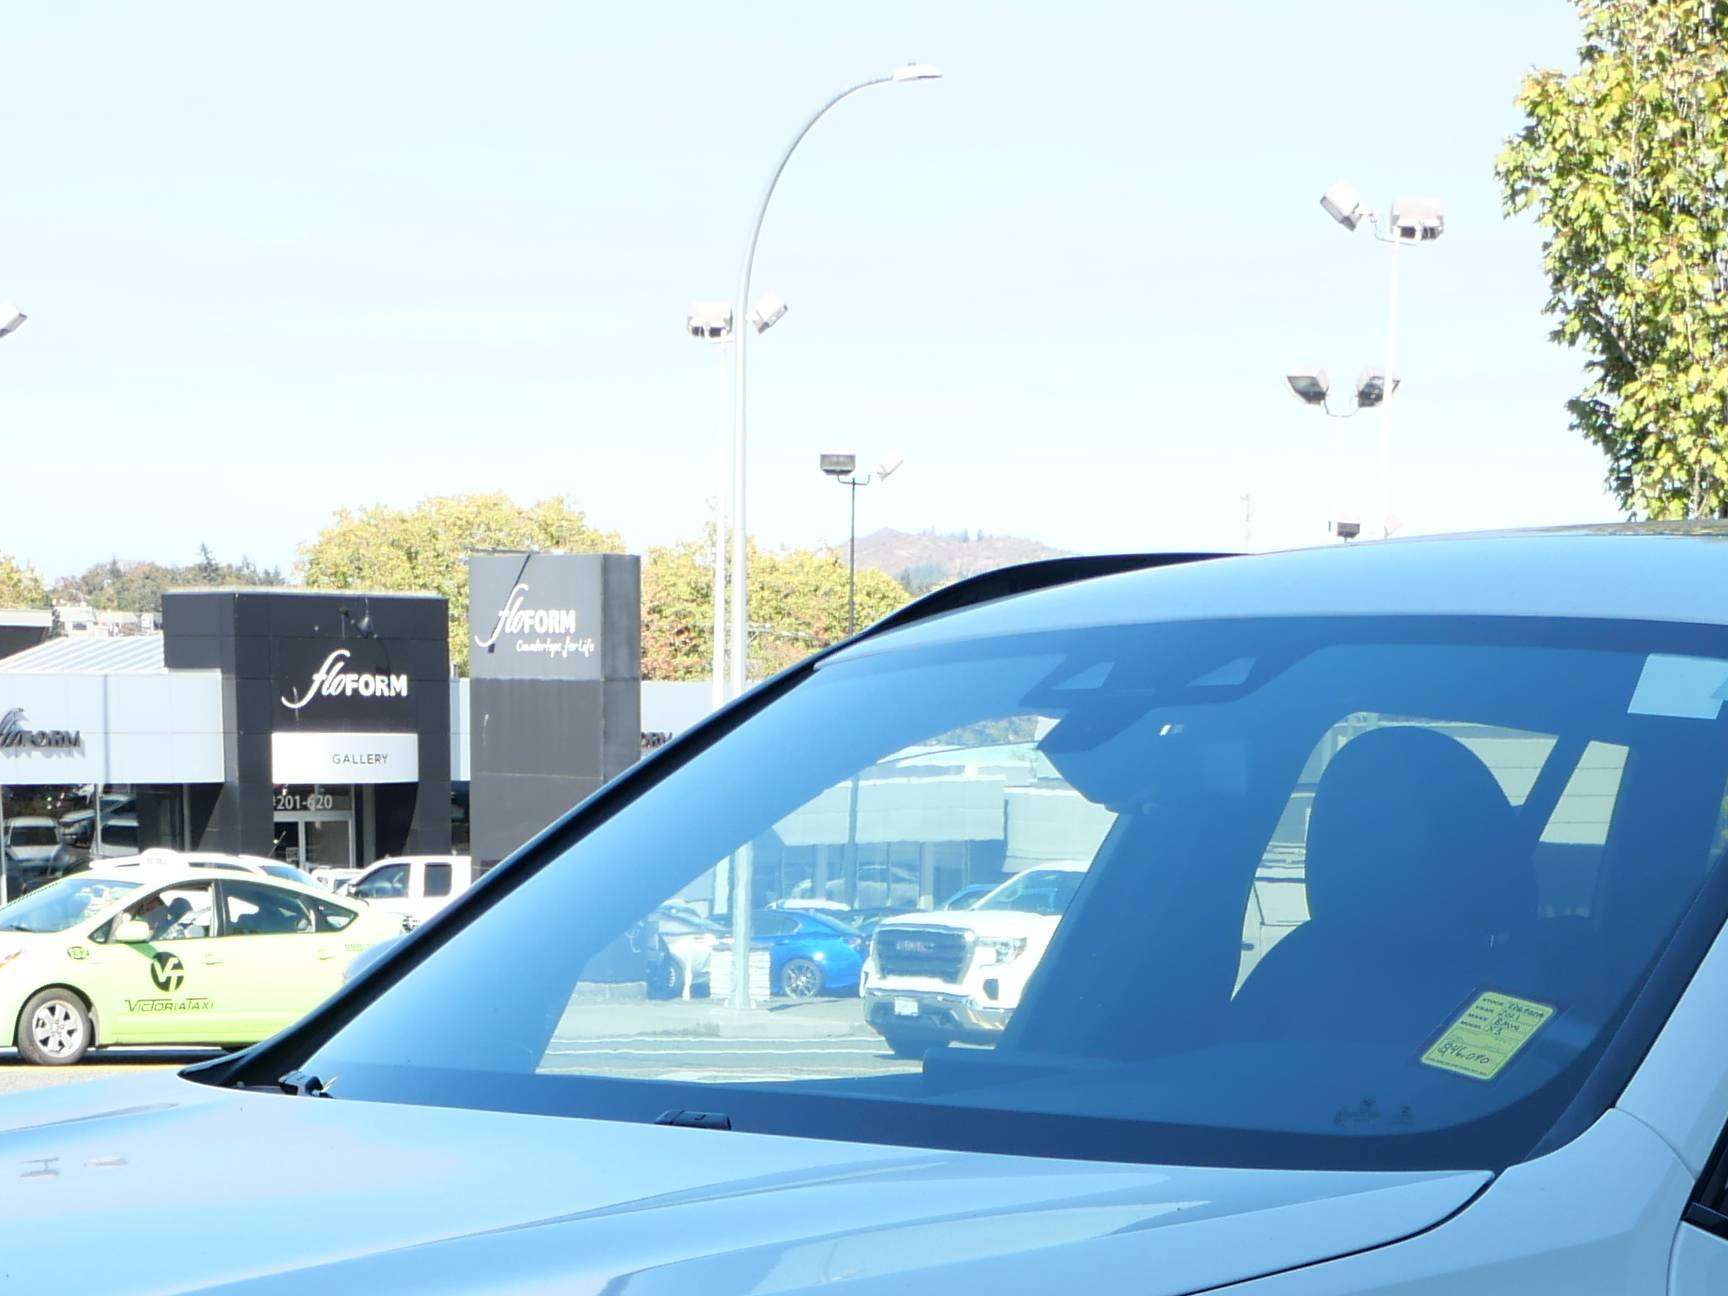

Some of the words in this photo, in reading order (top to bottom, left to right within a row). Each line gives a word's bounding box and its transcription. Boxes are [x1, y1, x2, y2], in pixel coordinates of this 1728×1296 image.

[474, 583, 576, 647] floFORM
[281, 650, 408, 709] floFORM
[332, 753, 389, 766] GALLERY
